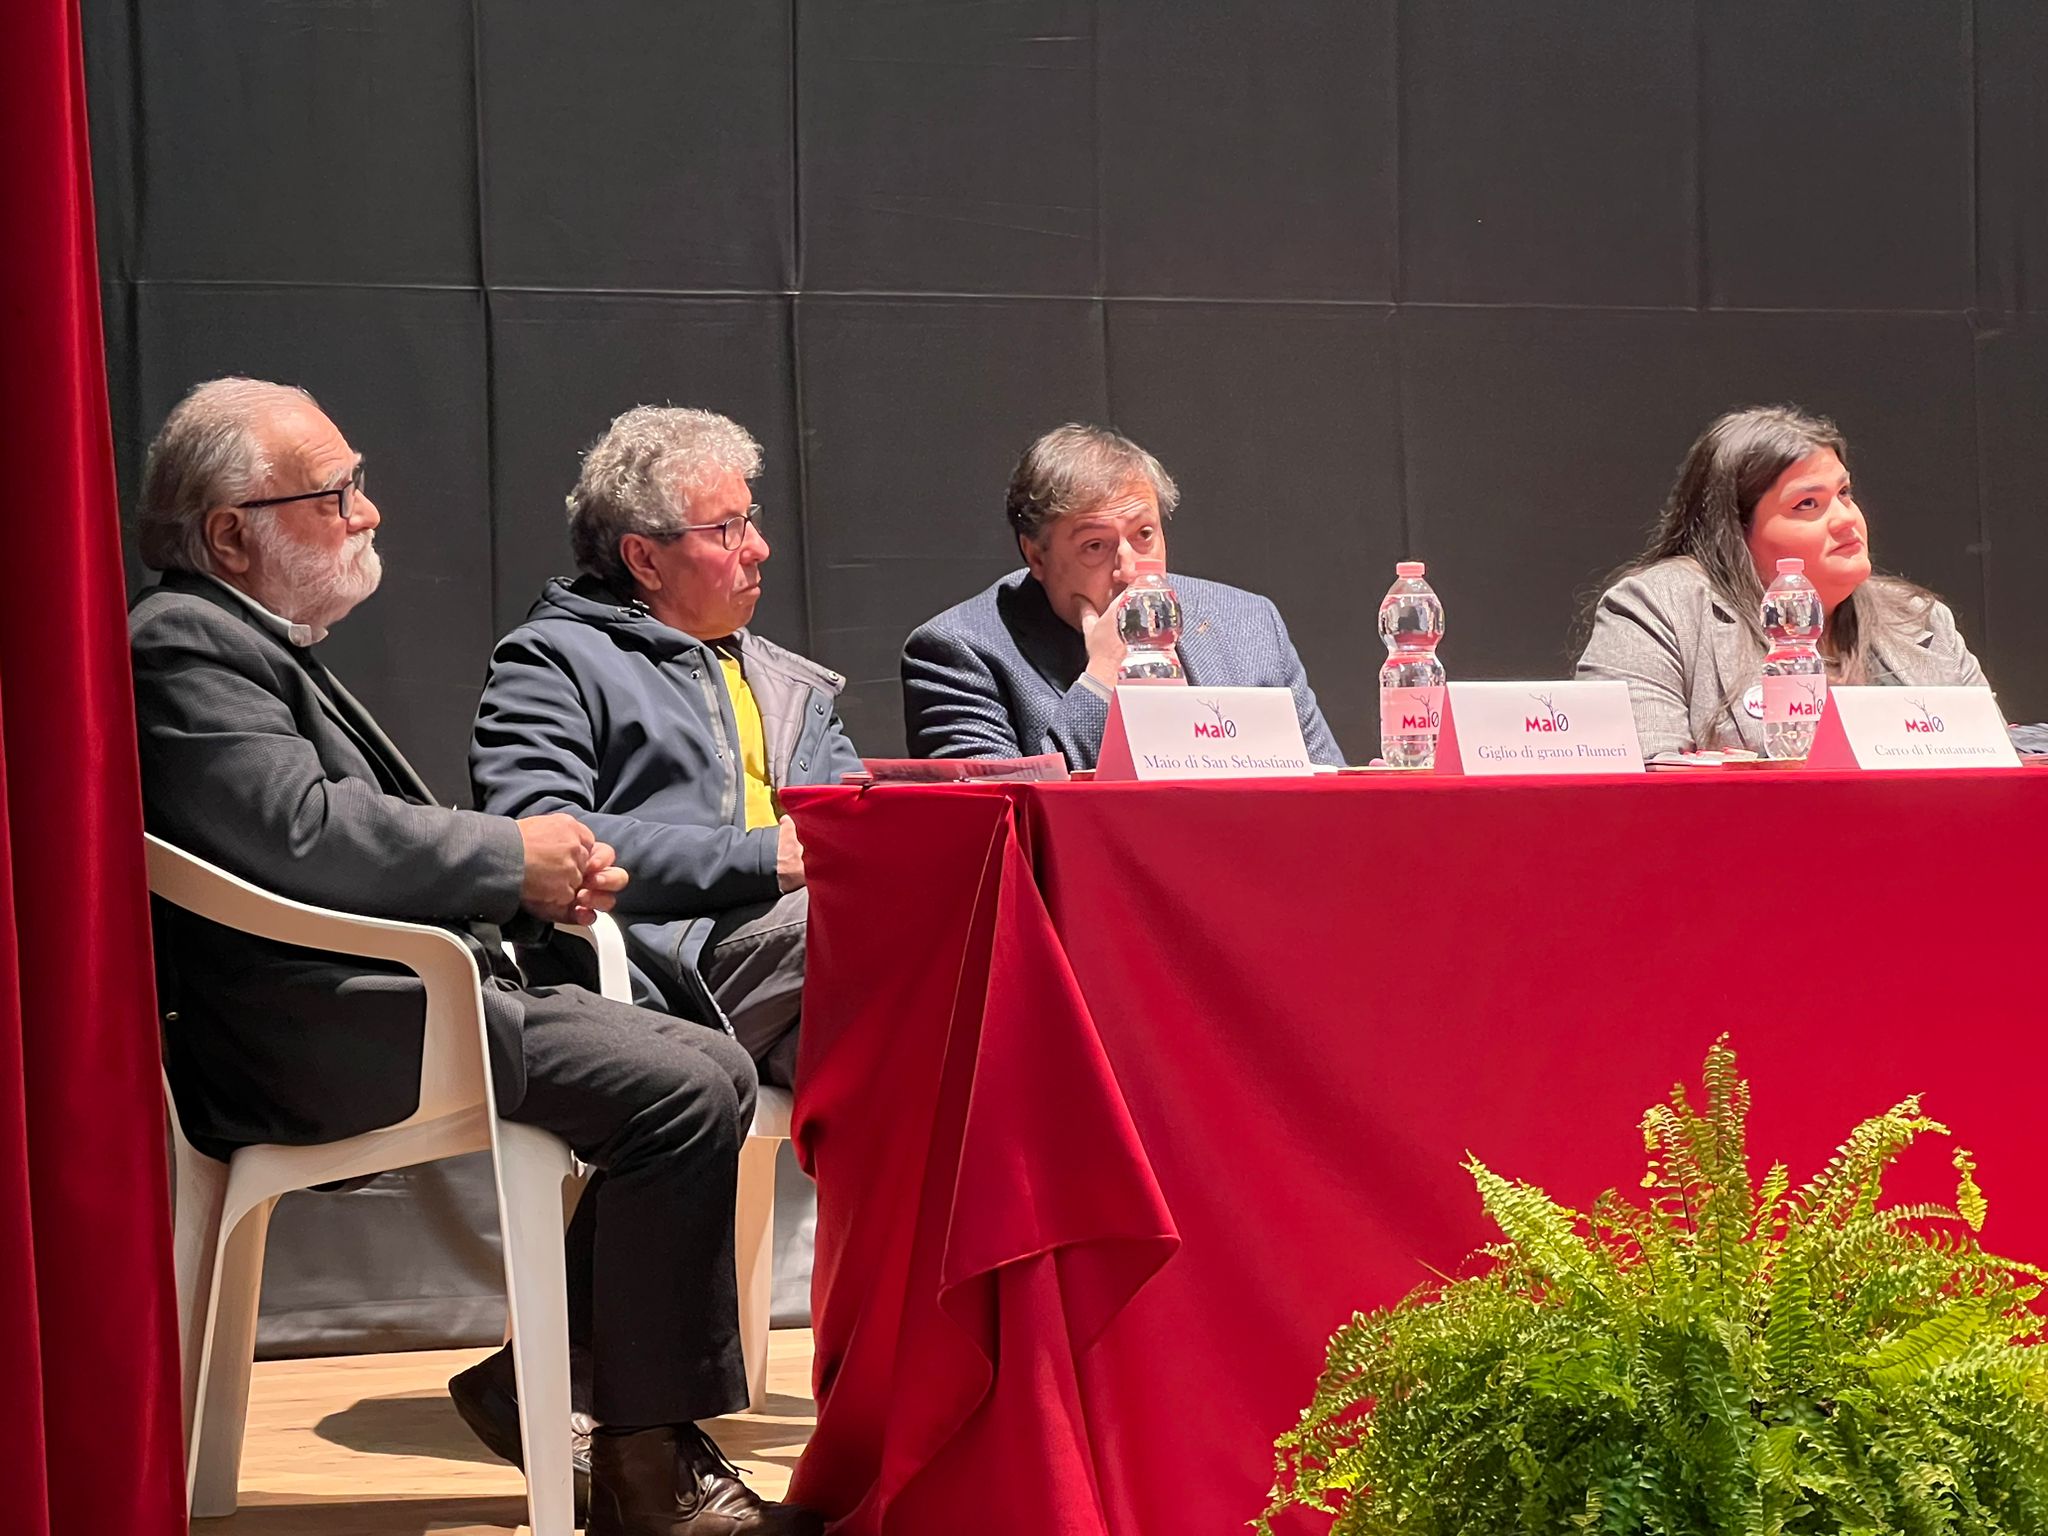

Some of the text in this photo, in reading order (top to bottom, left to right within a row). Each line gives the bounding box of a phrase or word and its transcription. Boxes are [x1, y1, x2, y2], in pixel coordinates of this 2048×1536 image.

[1478, 743, 1627, 761] Giglio di grano Flumeri
[1911, 744, 1924, 755] di
[1144, 753, 1304, 769] Maio di San Sebastiano
